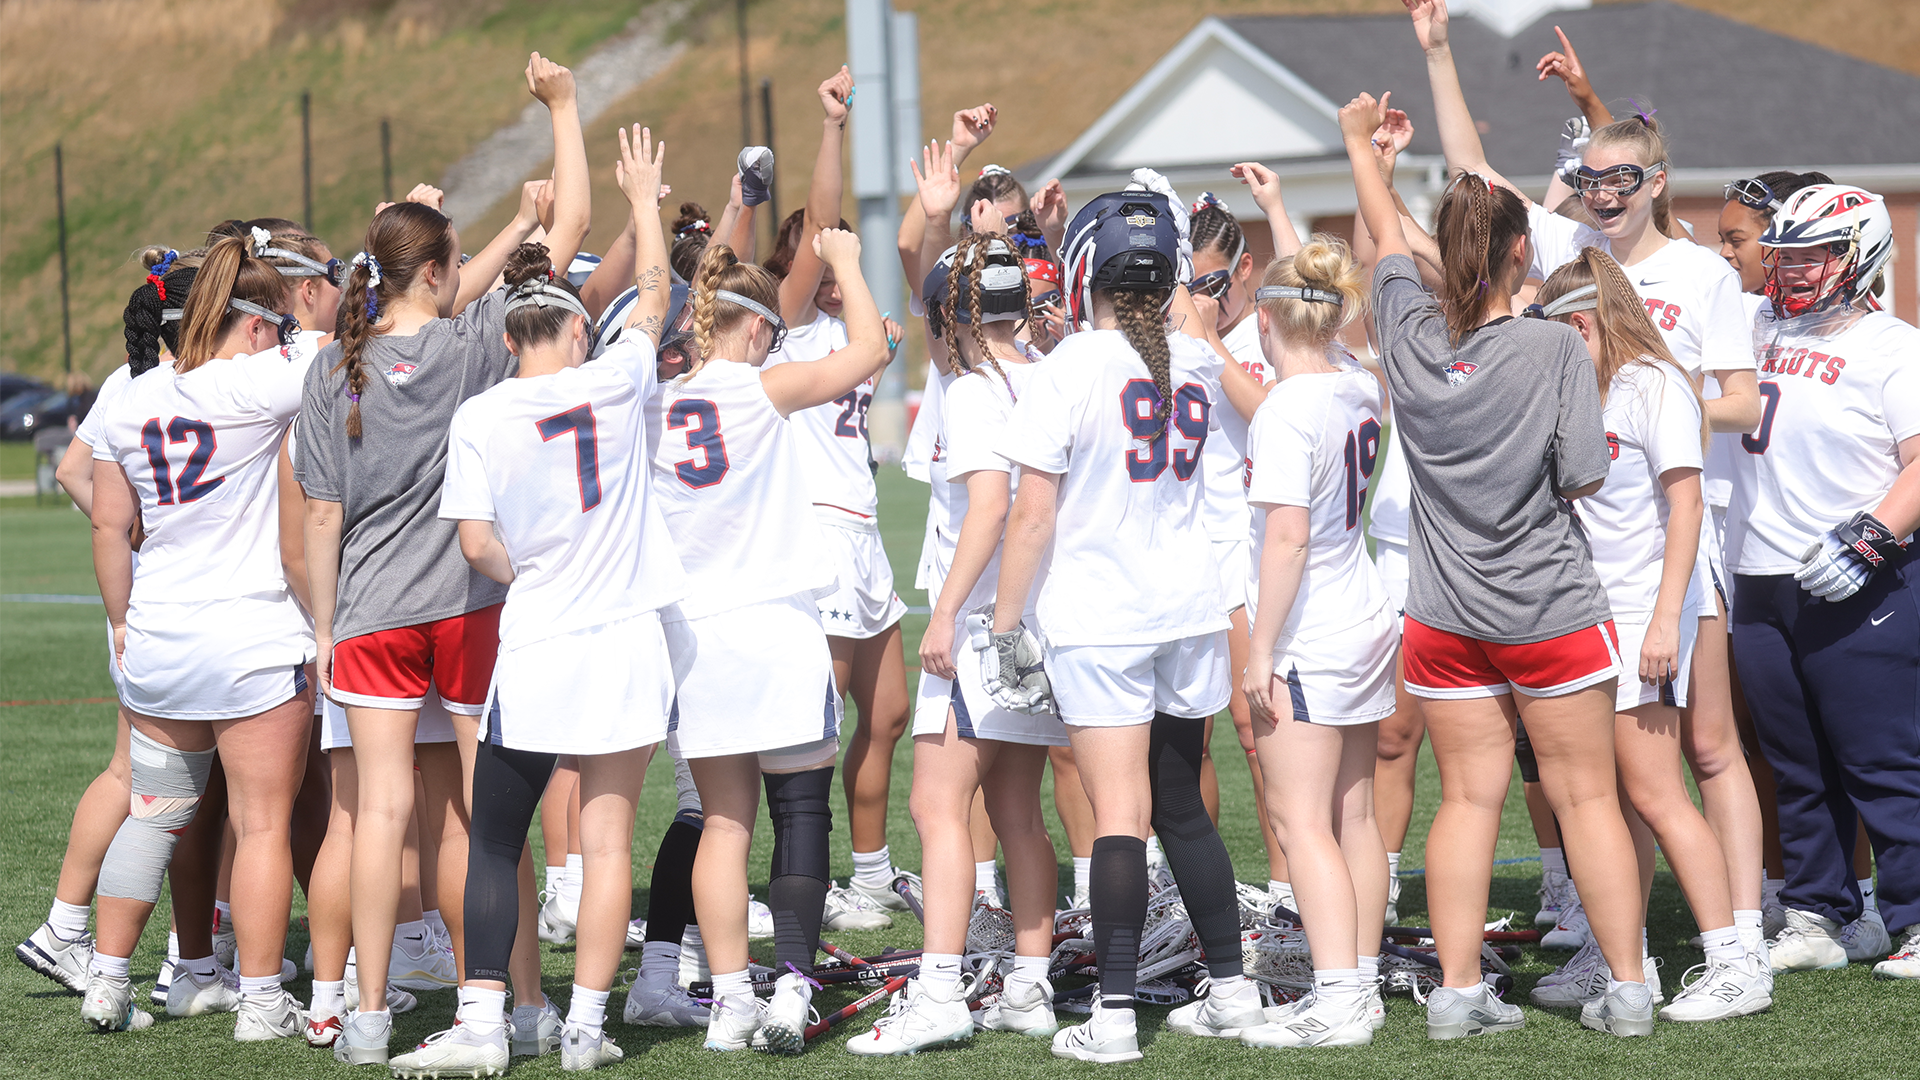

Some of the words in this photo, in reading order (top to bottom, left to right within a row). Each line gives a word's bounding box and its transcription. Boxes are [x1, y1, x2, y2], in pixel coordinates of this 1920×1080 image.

[1640, 296, 1682, 332] TS
[1757, 343, 1847, 386] RIOTS
[140, 415, 226, 506] 12
[534, 401, 602, 514] 7
[666, 398, 730, 490] 3
[1119, 378, 1212, 483] 99
[1343, 416, 1381, 532] 19
[1851, 539, 1885, 568] STX
[857, 967, 890, 980] GAIT
